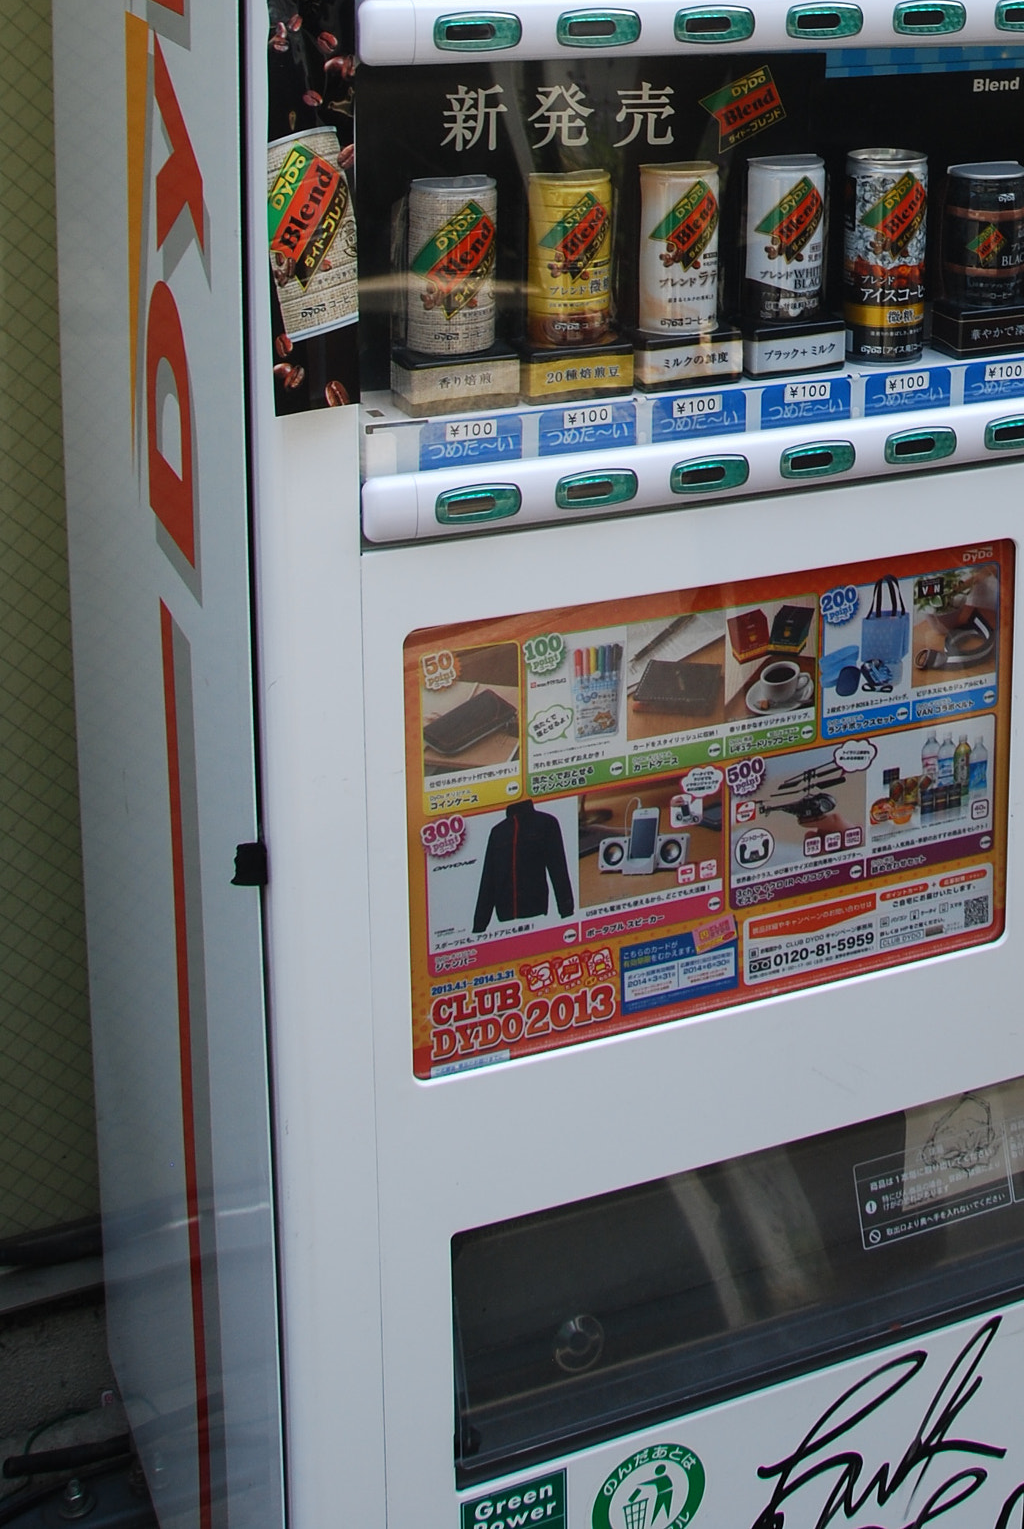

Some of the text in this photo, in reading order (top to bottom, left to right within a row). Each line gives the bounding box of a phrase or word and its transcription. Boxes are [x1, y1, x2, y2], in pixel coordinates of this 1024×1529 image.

[730, 71, 767, 98] DyDo
[972, 77, 1019, 92] Blend
[440, 82, 676, 152] 新発売
[722, 88, 776, 128] Blend
[271, 150, 307, 211] DyDo
[280, 165, 333, 252] Blend
[777, 191, 822, 241] Blend
[883, 186, 924, 237] Blend
[304, 180, 348, 269] ダイドーブレンド
[676, 194, 717, 247] Blend
[563, 204, 608, 260] Blend
[432, 222, 493, 292] Blend
[301, 303, 326, 318] DyDo
[663, 350, 730, 369] ミルクの鮮度
[438, 372, 492, 389] 香り焙煎
[545, 364, 621, 385] 20種焙煎豆
[989, 365, 1023, 379] ¥100
[790, 384, 827, 399] ¥100
[889, 375, 925, 391] ¥100
[677, 398, 717, 414] ¥100
[568, 409, 608, 425] ¥100
[450, 423, 493, 437] ¥100
[962, 547, 993, 562] DyDo
[821, 587, 857, 612] 200
[524, 634, 563, 661] 100
[423, 654, 452, 675] 50
[916, 699, 975, 717] VAN コラボベルト
[827, 715, 896, 735] ランチボックスセット
[633, 757, 679, 772] カードケース
[727, 758, 764, 783] 500
[532, 765, 594, 786] 洗たくでおとせる
[532, 777, 586, 793] サインペン6色
[430, 795, 479, 810] コインケース
[423, 817, 464, 844] 300
[871, 856, 926, 874] 詰め合わせセット
[885, 884, 924, 900] ポイントカード
[586, 914, 664, 937] ポータブル スピーカー
[786, 934, 824, 948] CLUB DYDO
[882, 930, 922, 948] CLUB DYDO
[623, 940, 679, 961] こちらのカードが
[773, 932, 874, 968] 0120-81-5959
[435, 956, 476, 971] ジャンパー
[430, 981, 522, 1026] CLUB
[430, 985, 616, 1061] DYDO 2013
[602, 1445, 696, 1497] のんだあとは
[474, 1482, 553, 1521] Green
[472, 1500, 556, 1529] Power
